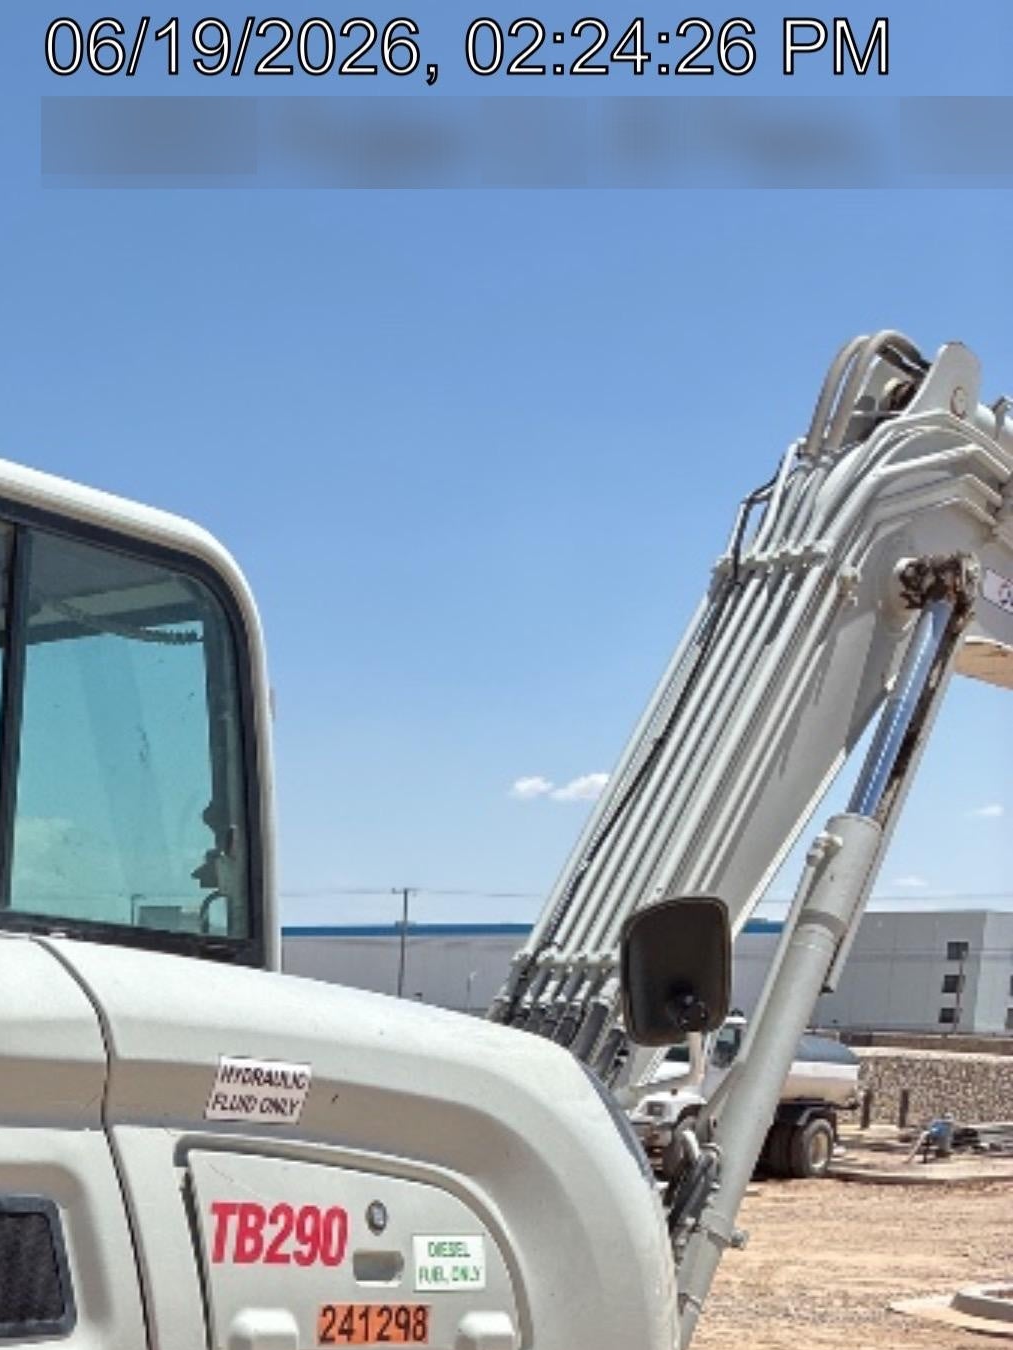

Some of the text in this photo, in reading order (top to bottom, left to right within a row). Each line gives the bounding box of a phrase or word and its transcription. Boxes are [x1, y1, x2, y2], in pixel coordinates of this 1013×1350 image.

[219, 1064, 307, 1090] HYDRAULIC
[211, 1093, 300, 1117] FLUID ONLY
[210, 1202, 349, 1267] TB290
[428, 1241, 471, 1257] DIESEL
[418, 1265, 481, 1284] FUEL ONLY
[319, 1304, 428, 1343] 241298
